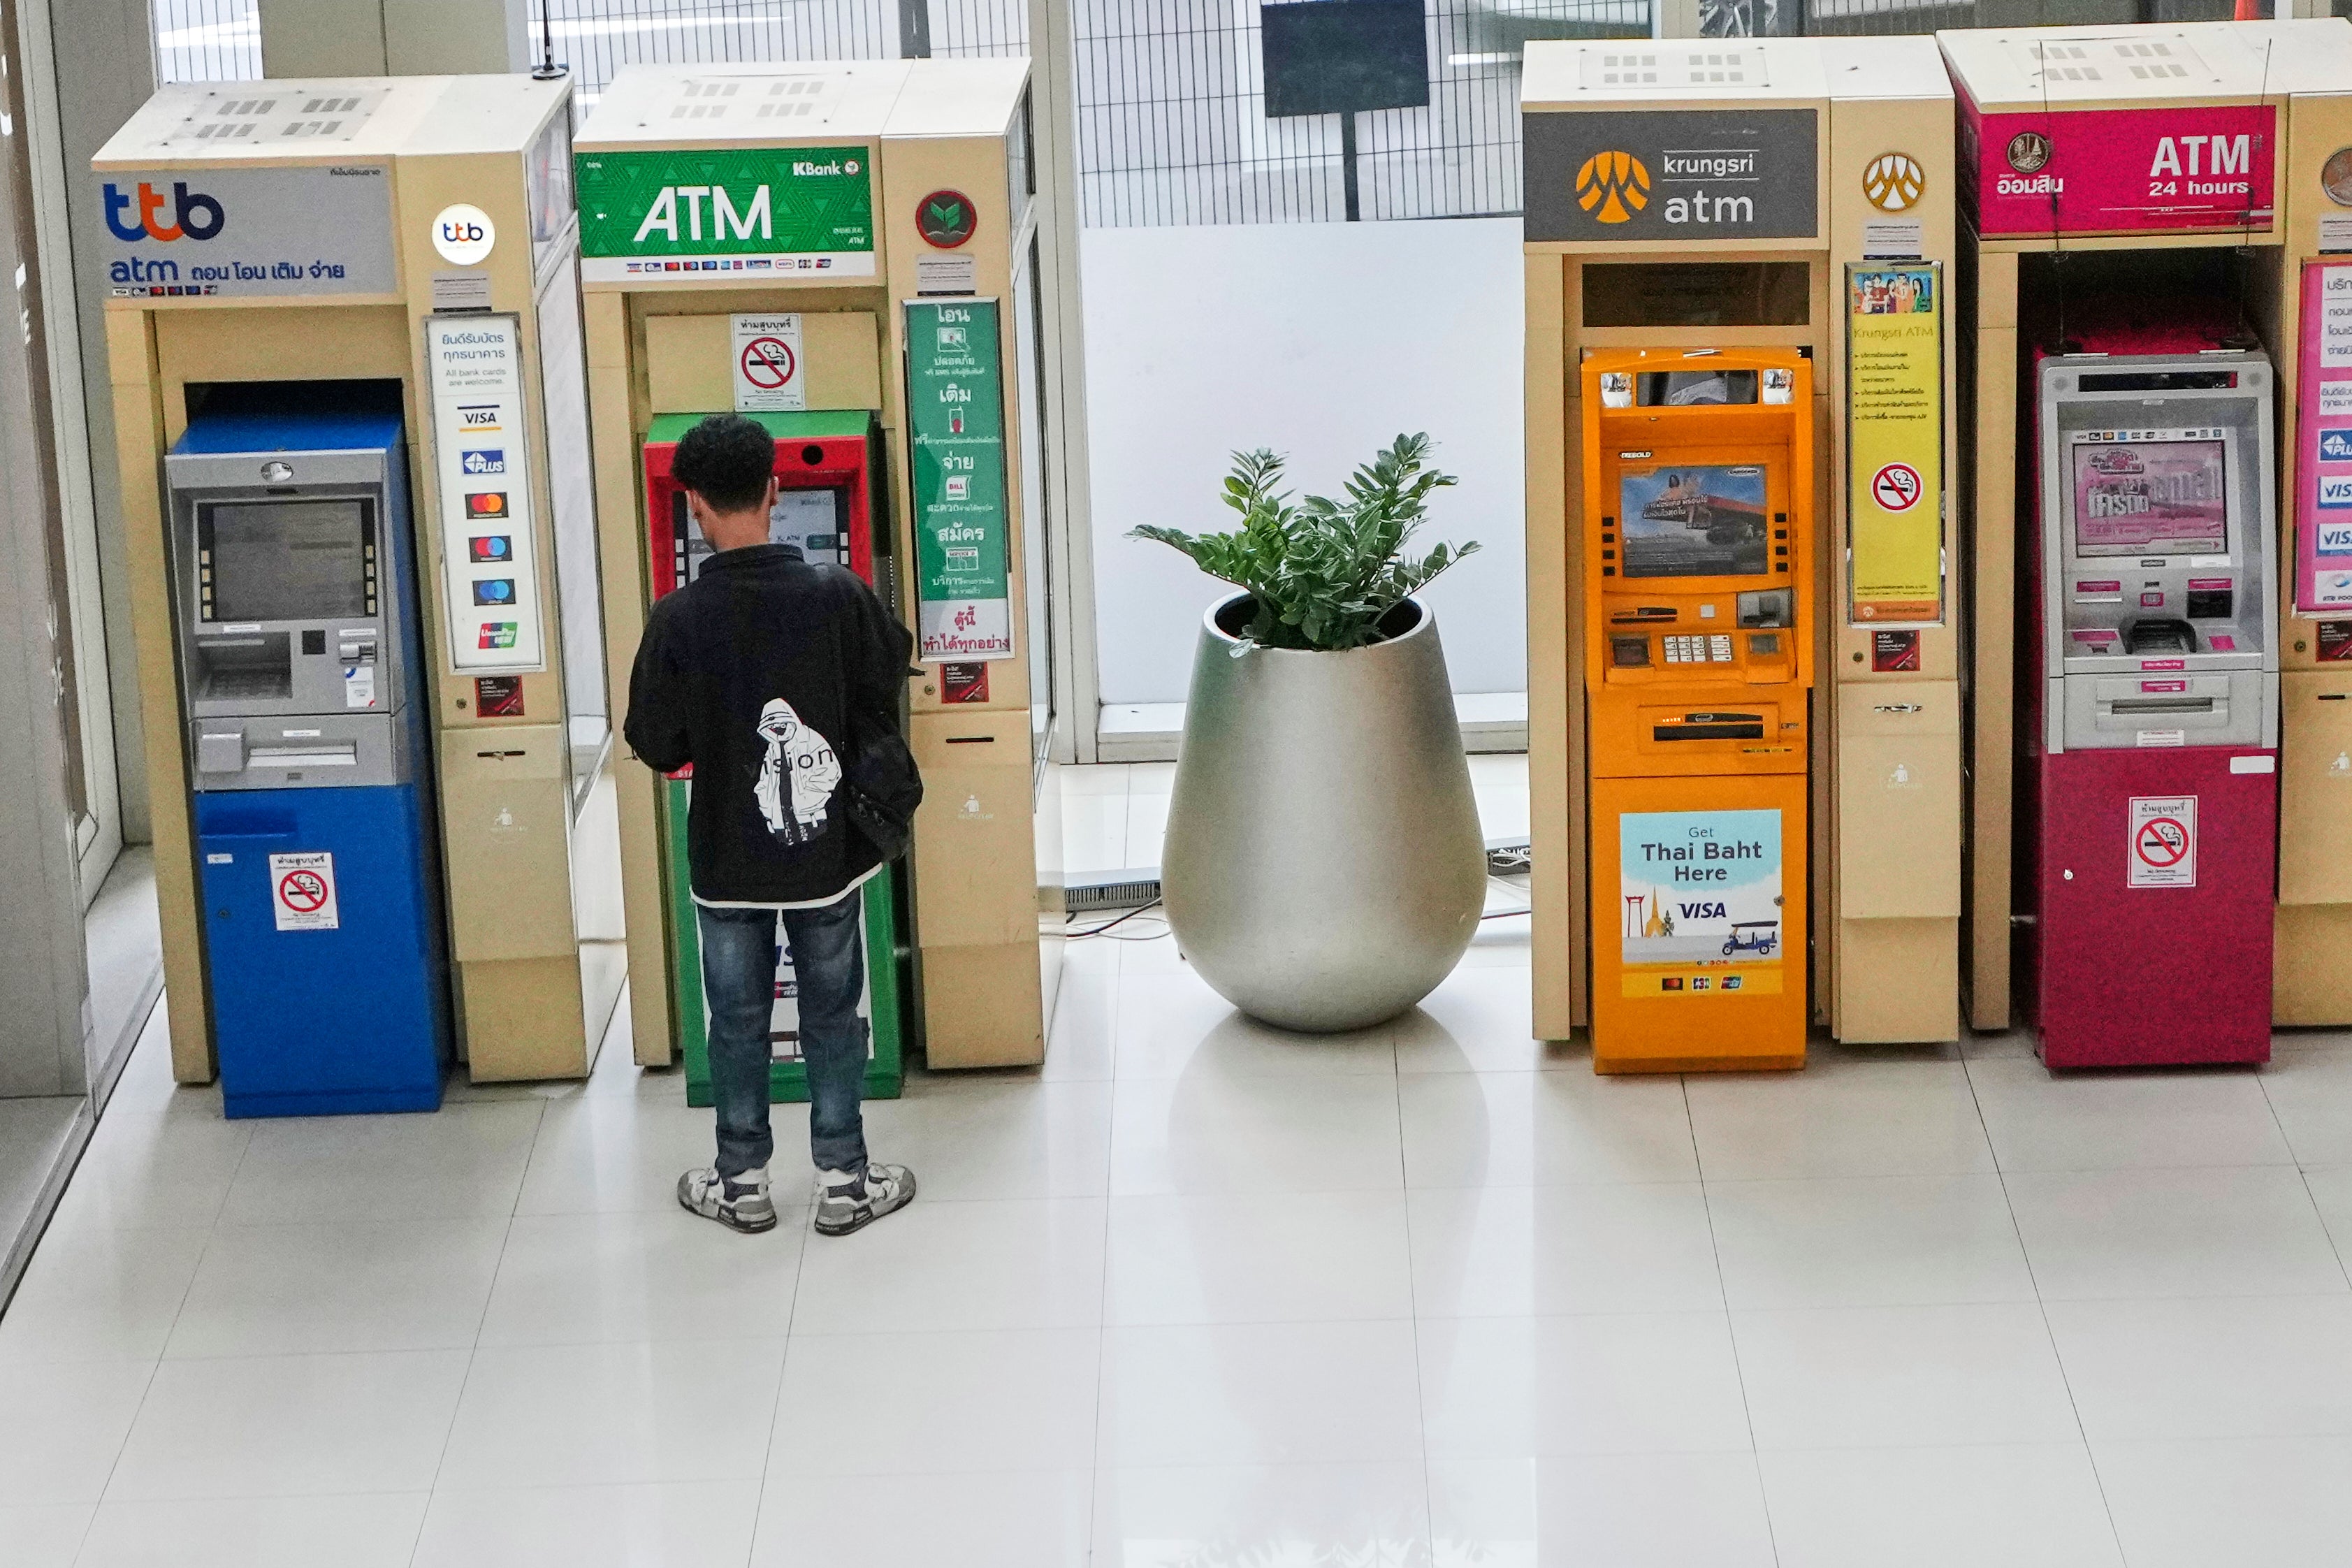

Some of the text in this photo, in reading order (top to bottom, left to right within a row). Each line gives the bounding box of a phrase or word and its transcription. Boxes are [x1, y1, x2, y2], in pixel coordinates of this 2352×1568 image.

[2149, 134, 2250, 177] ATM
[792, 161, 841, 176] KBank
[1663, 153, 1754, 177] krungsri
[1997, 175, 2063, 194] ออมสิน
[2149, 180, 2249, 196] 24 hours
[103, 182, 225, 242] ttb
[633, 184, 772, 242] ATM
[1664, 190, 1754, 224] atm
[443, 222, 484, 242] ttb
[110, 256, 179, 282] atm
[232, 261, 266, 280] โอน
[2328, 279, 2352, 290] บริก
[935, 304, 971, 322] โอน
[442, 333, 504, 344] ยินดีรับบัตร
[1854, 326, 1933, 341] Krungsri ATM
[444, 349, 505, 363] ทุกธนาคาร
[940, 384, 971, 402] เติม
[464, 412, 497, 423] VISA
[2333, 444, 2352, 456] PLU
[475, 460, 504, 473] PLUS
[942, 451, 974, 470] จ่าย
[2325, 484, 2352, 497] VIS
[937, 521, 985, 542] สมัคร
[2324, 531, 2352, 544] VIS
[954, 605, 975, 631] ตู้นี้
[1689, 827, 1714, 838] Get
[1641, 840, 1762, 861] Thai Baht
[1675, 866, 1727, 881] Here
[1677, 902, 1727, 919] VISA
